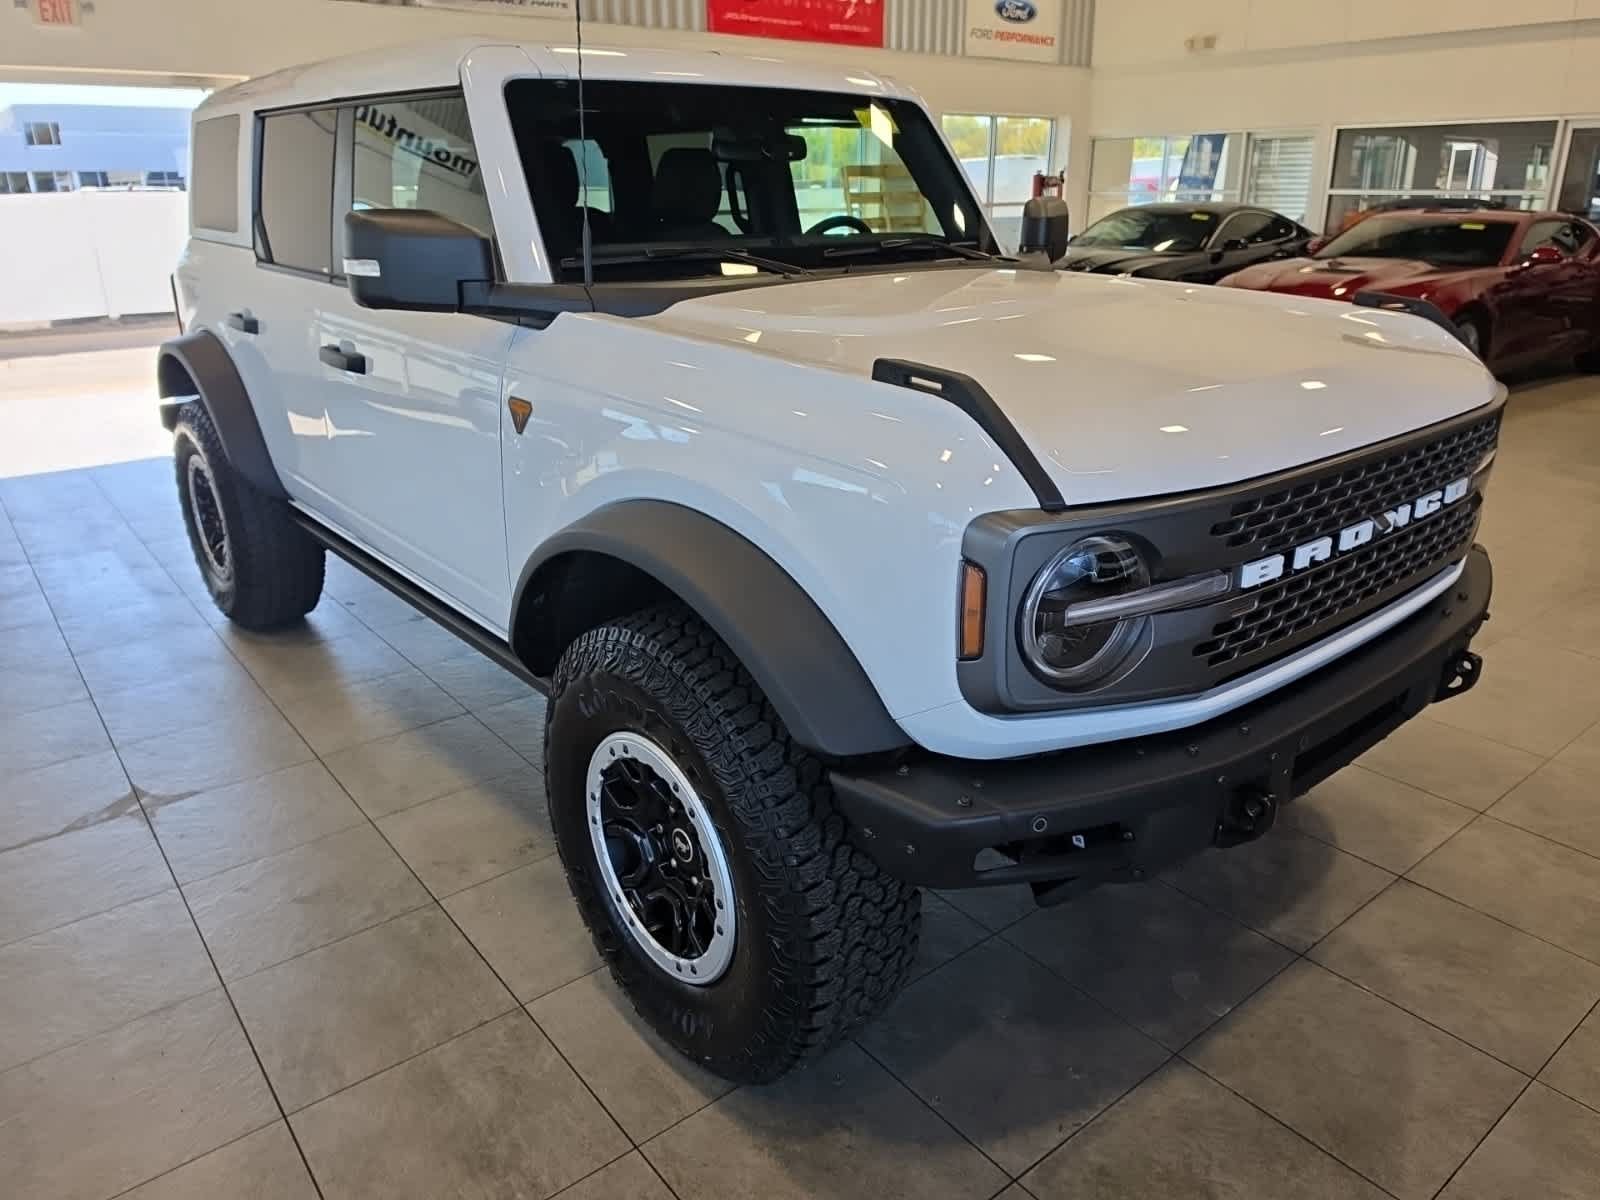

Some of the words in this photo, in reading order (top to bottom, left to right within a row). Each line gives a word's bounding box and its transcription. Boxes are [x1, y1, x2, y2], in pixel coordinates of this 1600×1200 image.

[39, 0, 73, 24] EXIT
[1000, 0, 1032, 20] Ford
[970, 27, 993, 41] FORD
[994, 29, 1055, 47] PERFORMANCE
[1240, 477, 1469, 589] BRONCO
